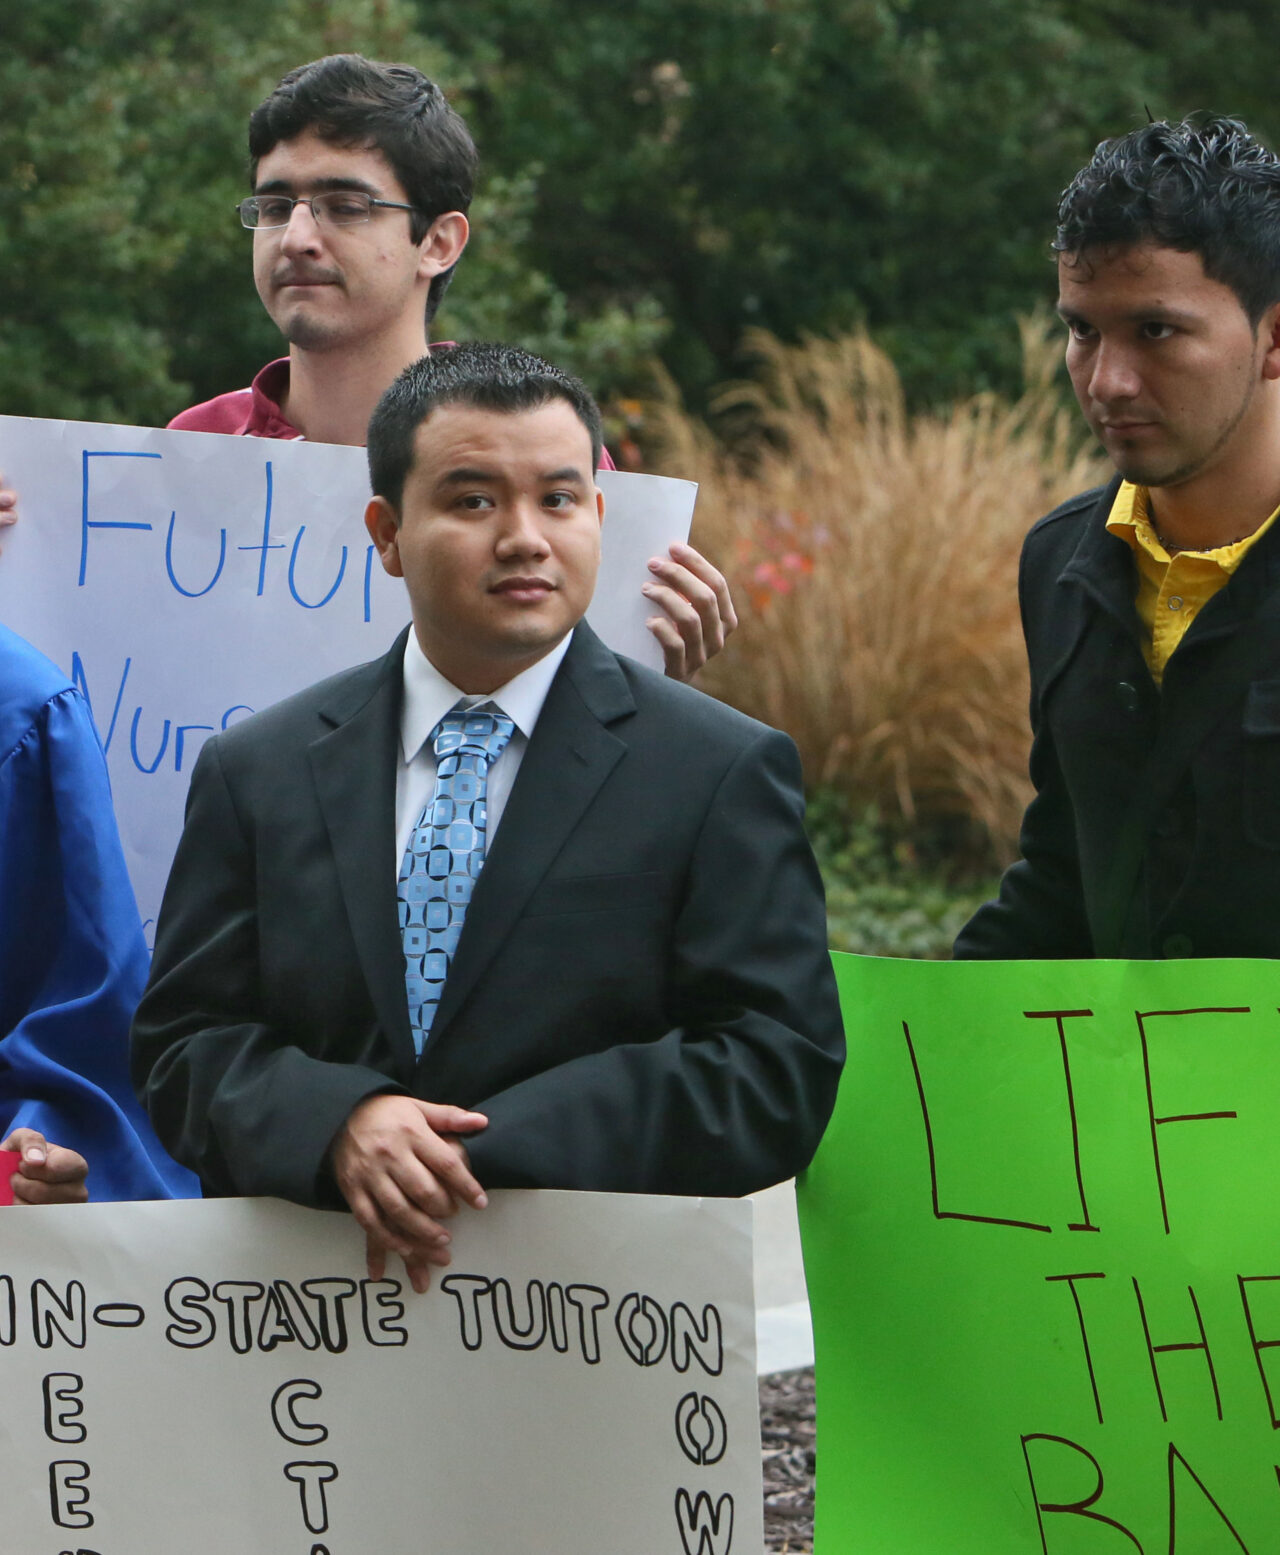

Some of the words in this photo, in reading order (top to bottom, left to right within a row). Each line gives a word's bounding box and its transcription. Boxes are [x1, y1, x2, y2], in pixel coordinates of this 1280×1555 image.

[903, 1008, 1280, 1235] LIF
[441, 1275, 724, 1377] TUITON
[1020, 1433, 1280, 1555] BA
